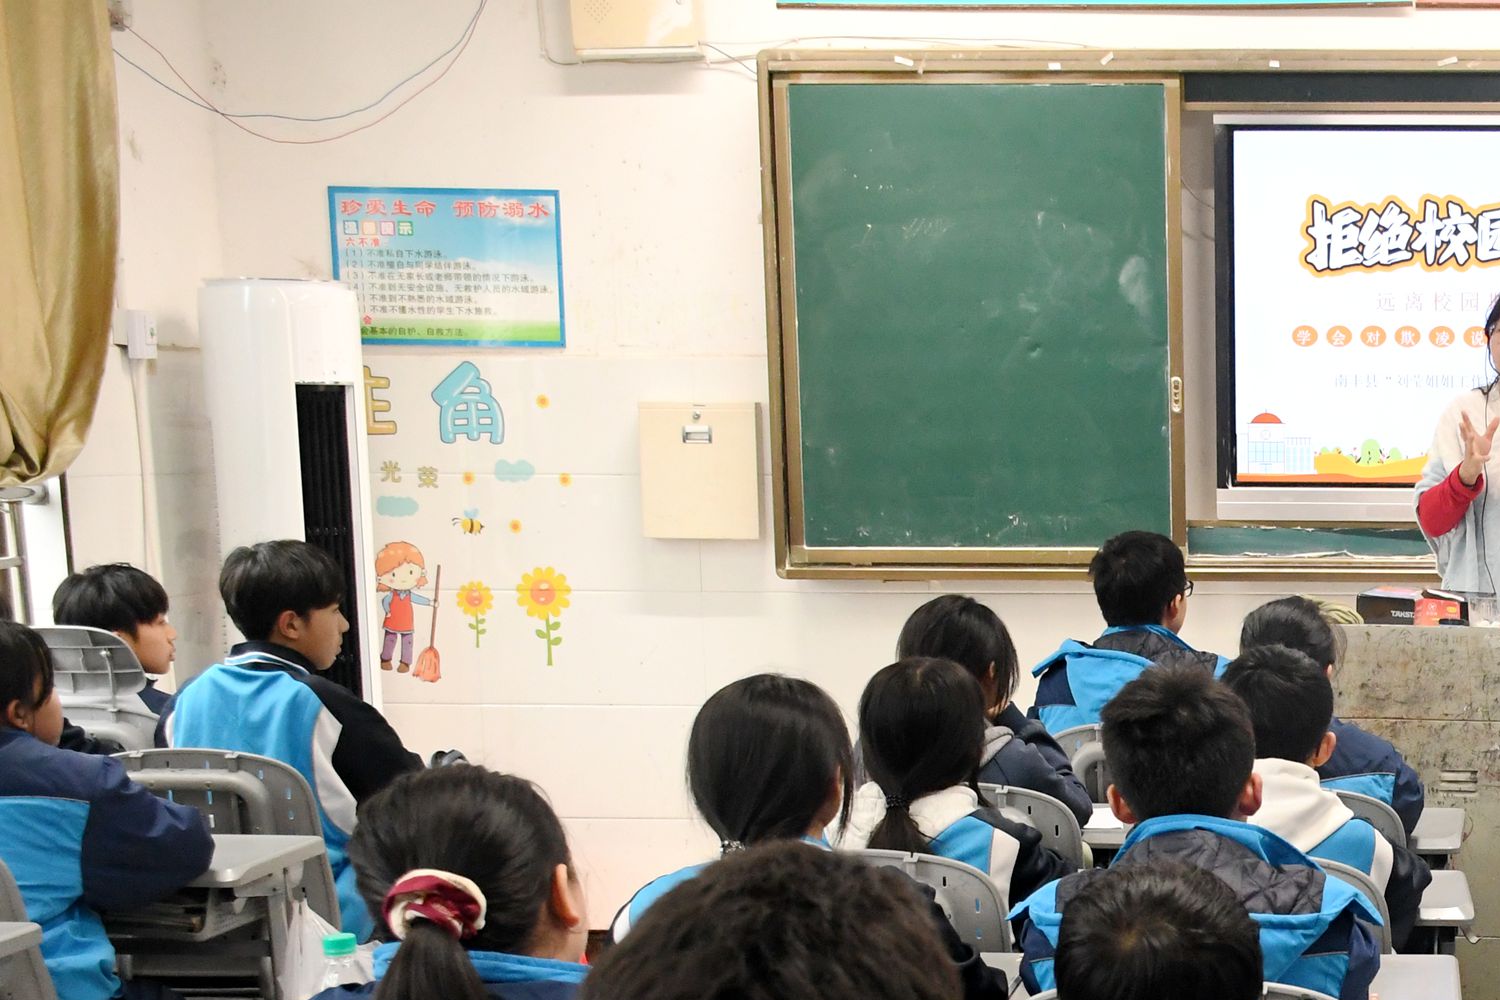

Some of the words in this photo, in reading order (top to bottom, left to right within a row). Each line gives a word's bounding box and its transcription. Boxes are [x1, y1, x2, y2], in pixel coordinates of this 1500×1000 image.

[341, 199, 436, 217] 珍爱生命
[453, 200, 549, 218] 预防溺水
[380, 460, 439, 488] 光荣
[1391, 610, 1415, 618] TAKST
